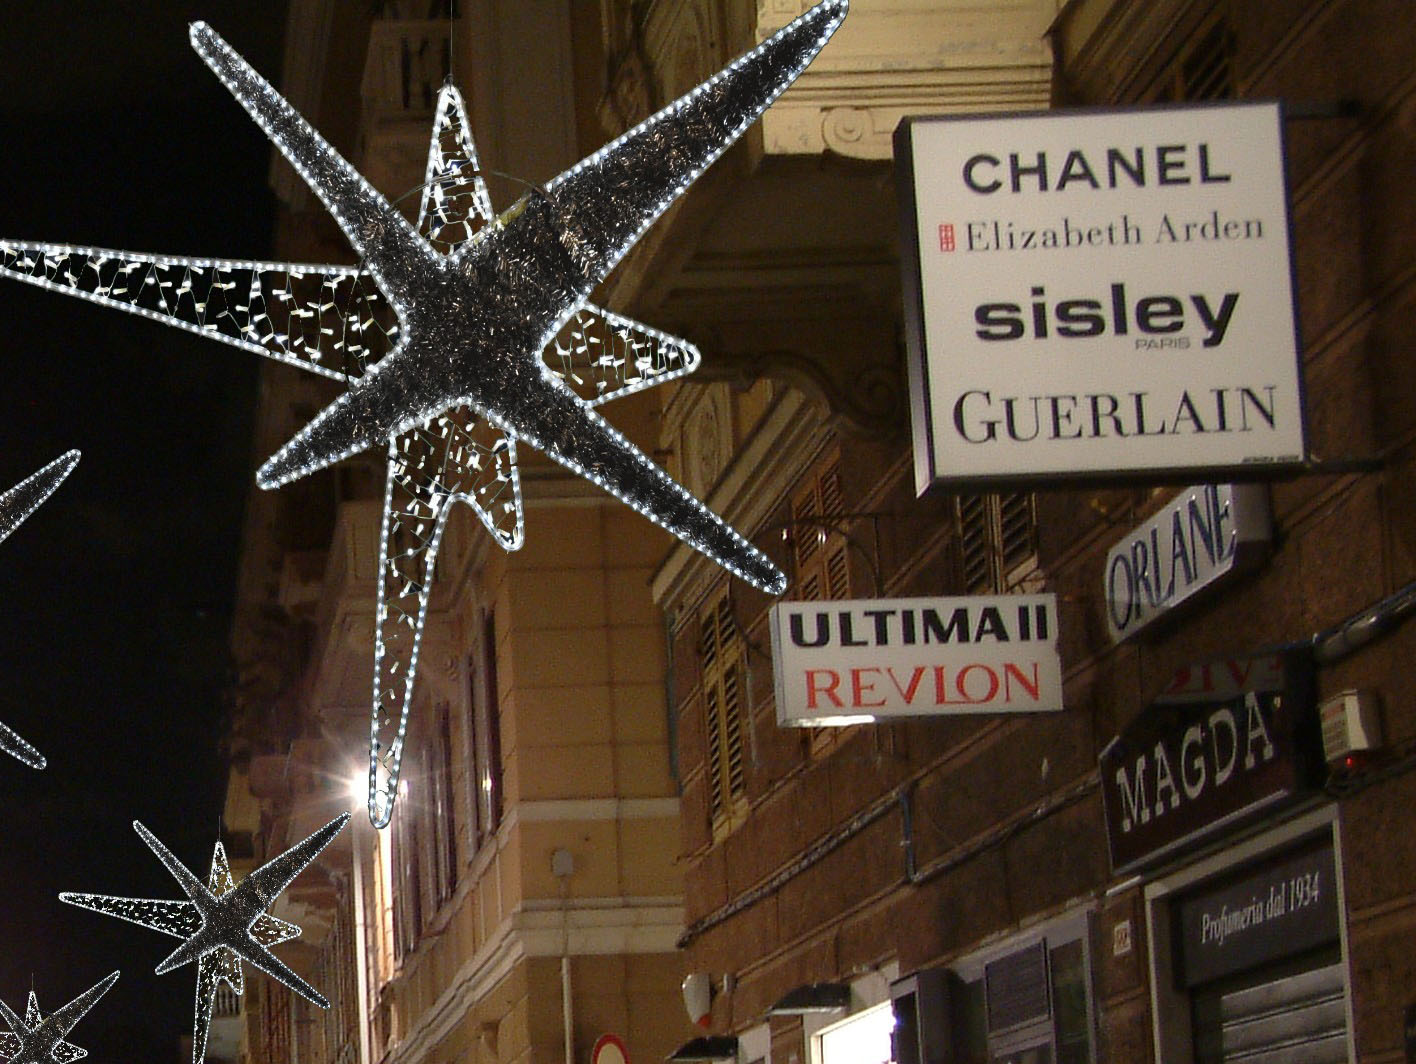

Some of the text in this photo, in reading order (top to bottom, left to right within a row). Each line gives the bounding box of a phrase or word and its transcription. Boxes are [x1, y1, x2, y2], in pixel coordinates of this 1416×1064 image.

[962, 144, 1232, 195] CHANEL
[966, 211, 1264, 252] Elizabeth Arden
[974, 283, 1240, 348] sisley
[1134, 337, 1191, 349] PARIS
[953, 385, 1277, 444] GUERLAIN
[1109, 484, 1236, 630] ORLANE
[790, 606, 1009, 647] ULTIMA
[805, 662, 1041, 709] REVLON
[1116, 691, 1274, 832] MAGDA
[1202, 871, 1320, 946] Profumeria dal 1934
